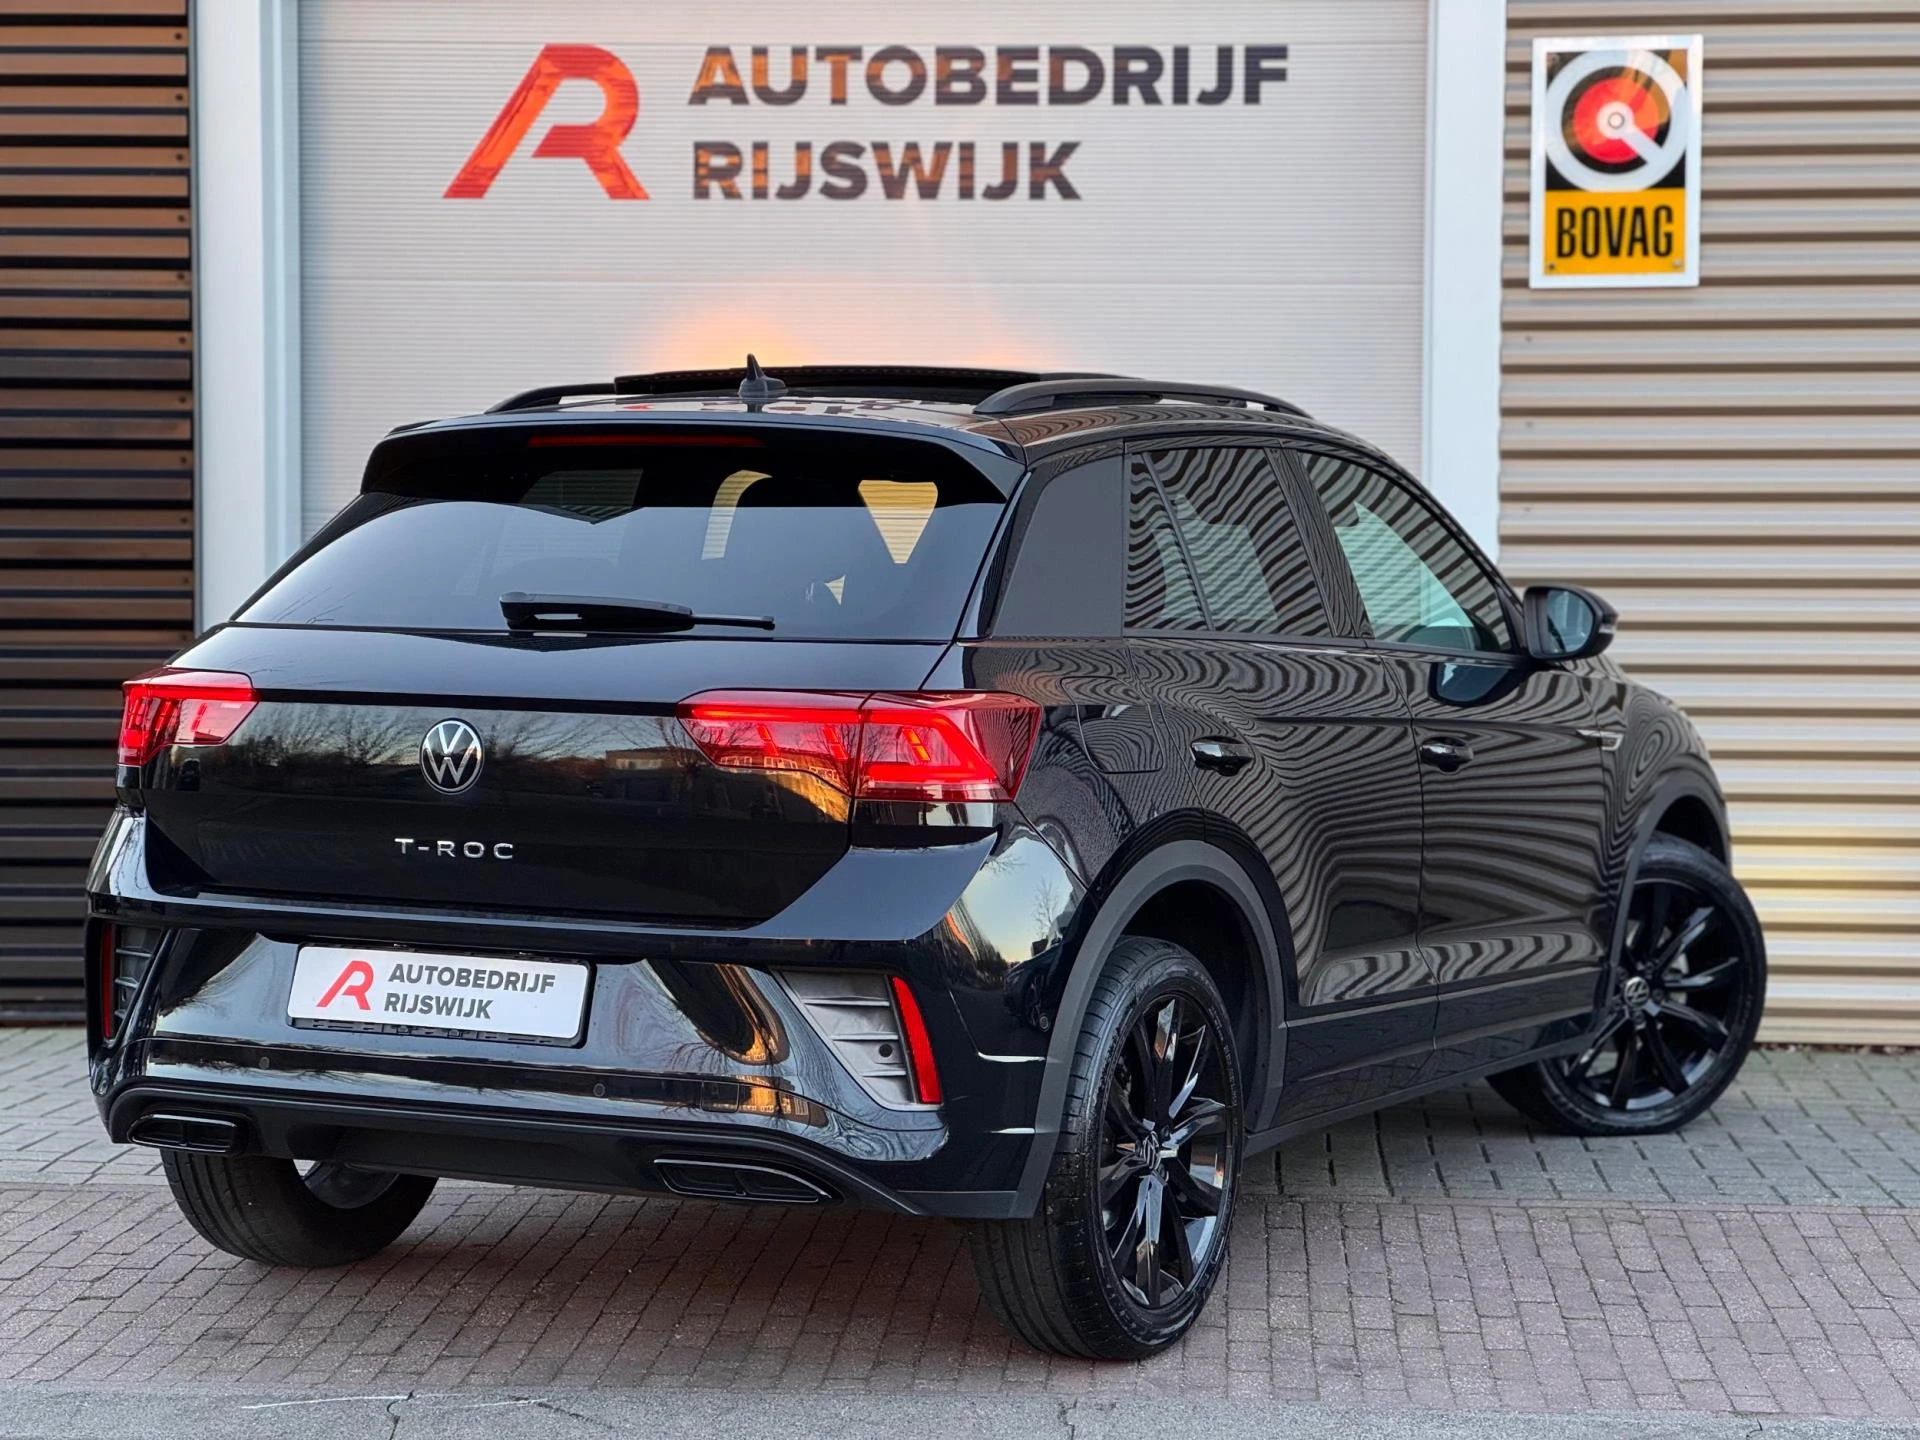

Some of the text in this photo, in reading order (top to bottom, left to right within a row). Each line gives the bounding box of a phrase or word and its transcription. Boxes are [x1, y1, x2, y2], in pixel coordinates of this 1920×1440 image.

[689, 45, 1289, 105] AUTOBEDRIJF
[692, 141, 1083, 199] RIJSWIJK
[1557, 205, 1673, 259] BOVAG
[394, 838, 514, 859] T-ROC
[387, 963, 556, 994] AUTOBEDRIJF
[383, 993, 492, 1019] RIJSWIJK
